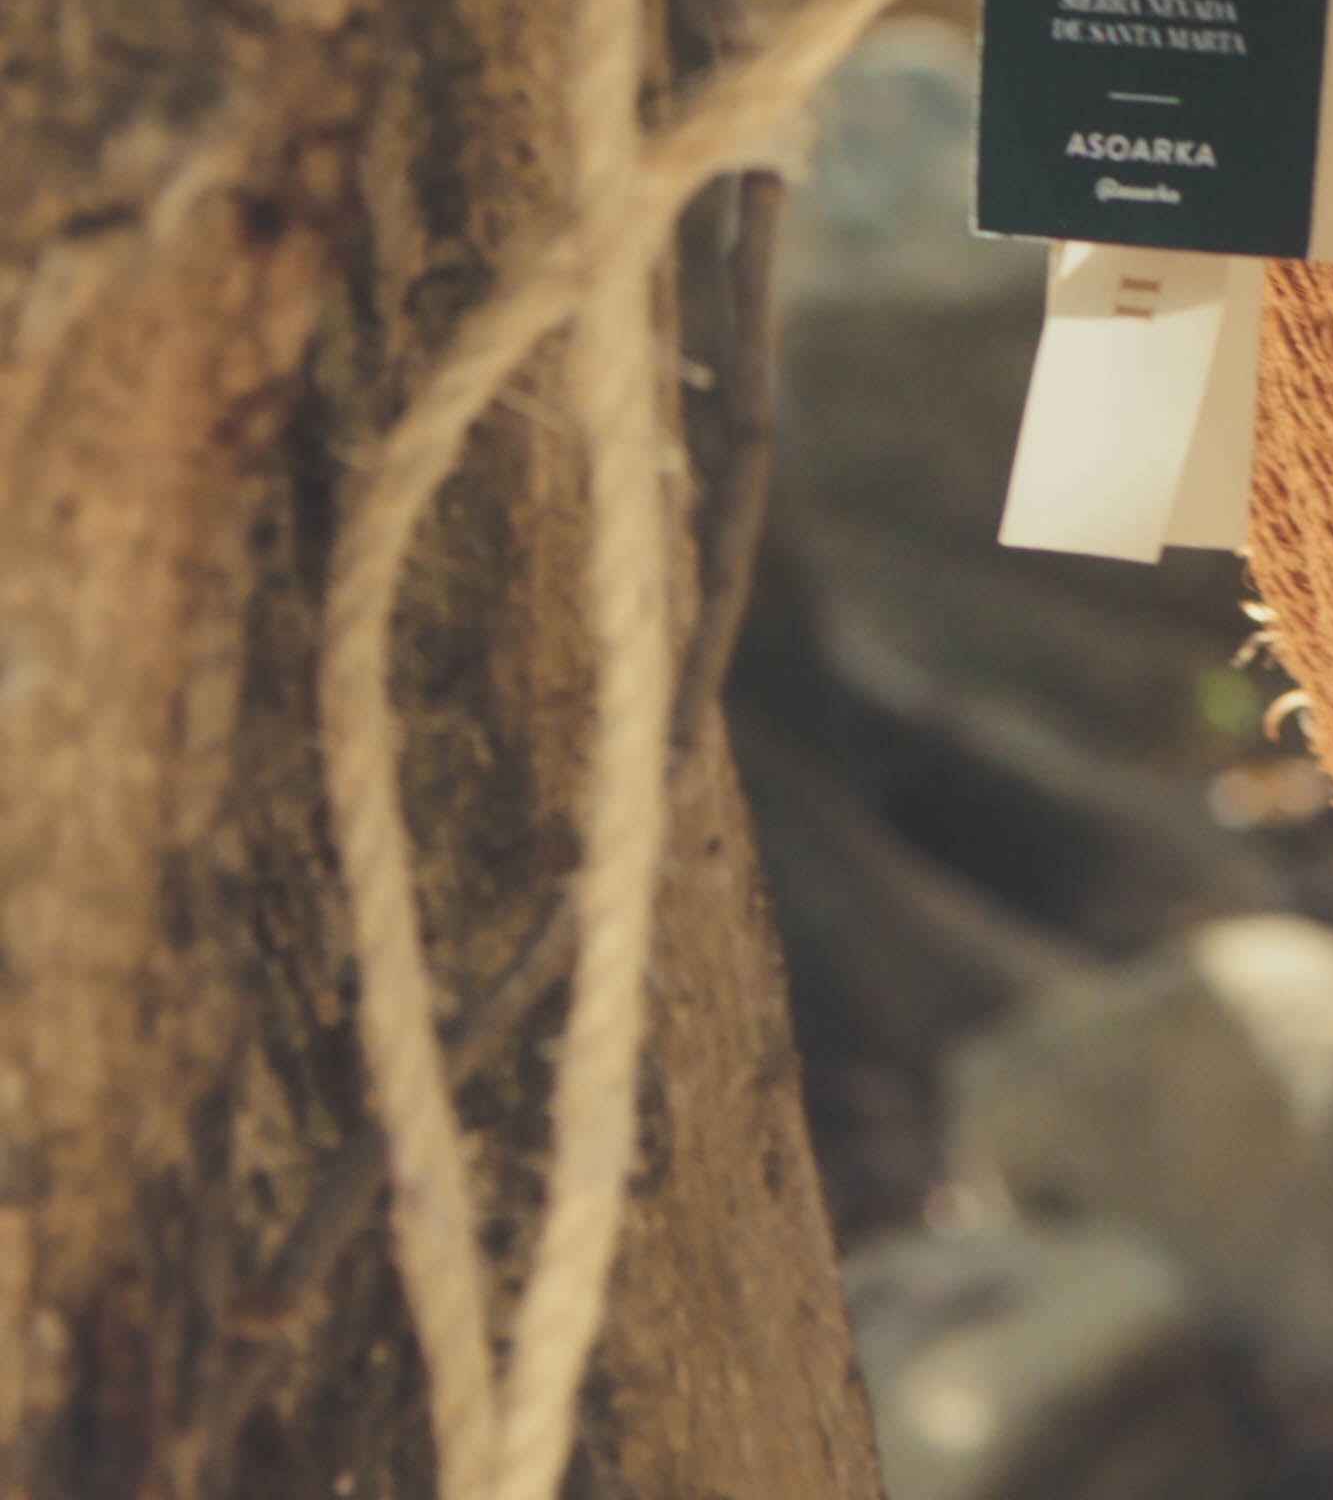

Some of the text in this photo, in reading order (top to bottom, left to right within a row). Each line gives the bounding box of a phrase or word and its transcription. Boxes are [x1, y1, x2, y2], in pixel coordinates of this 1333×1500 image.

[1052, 17, 1247, 54] DE SANTA MARTA
[1065, 131, 1216, 168] ASOARKA
